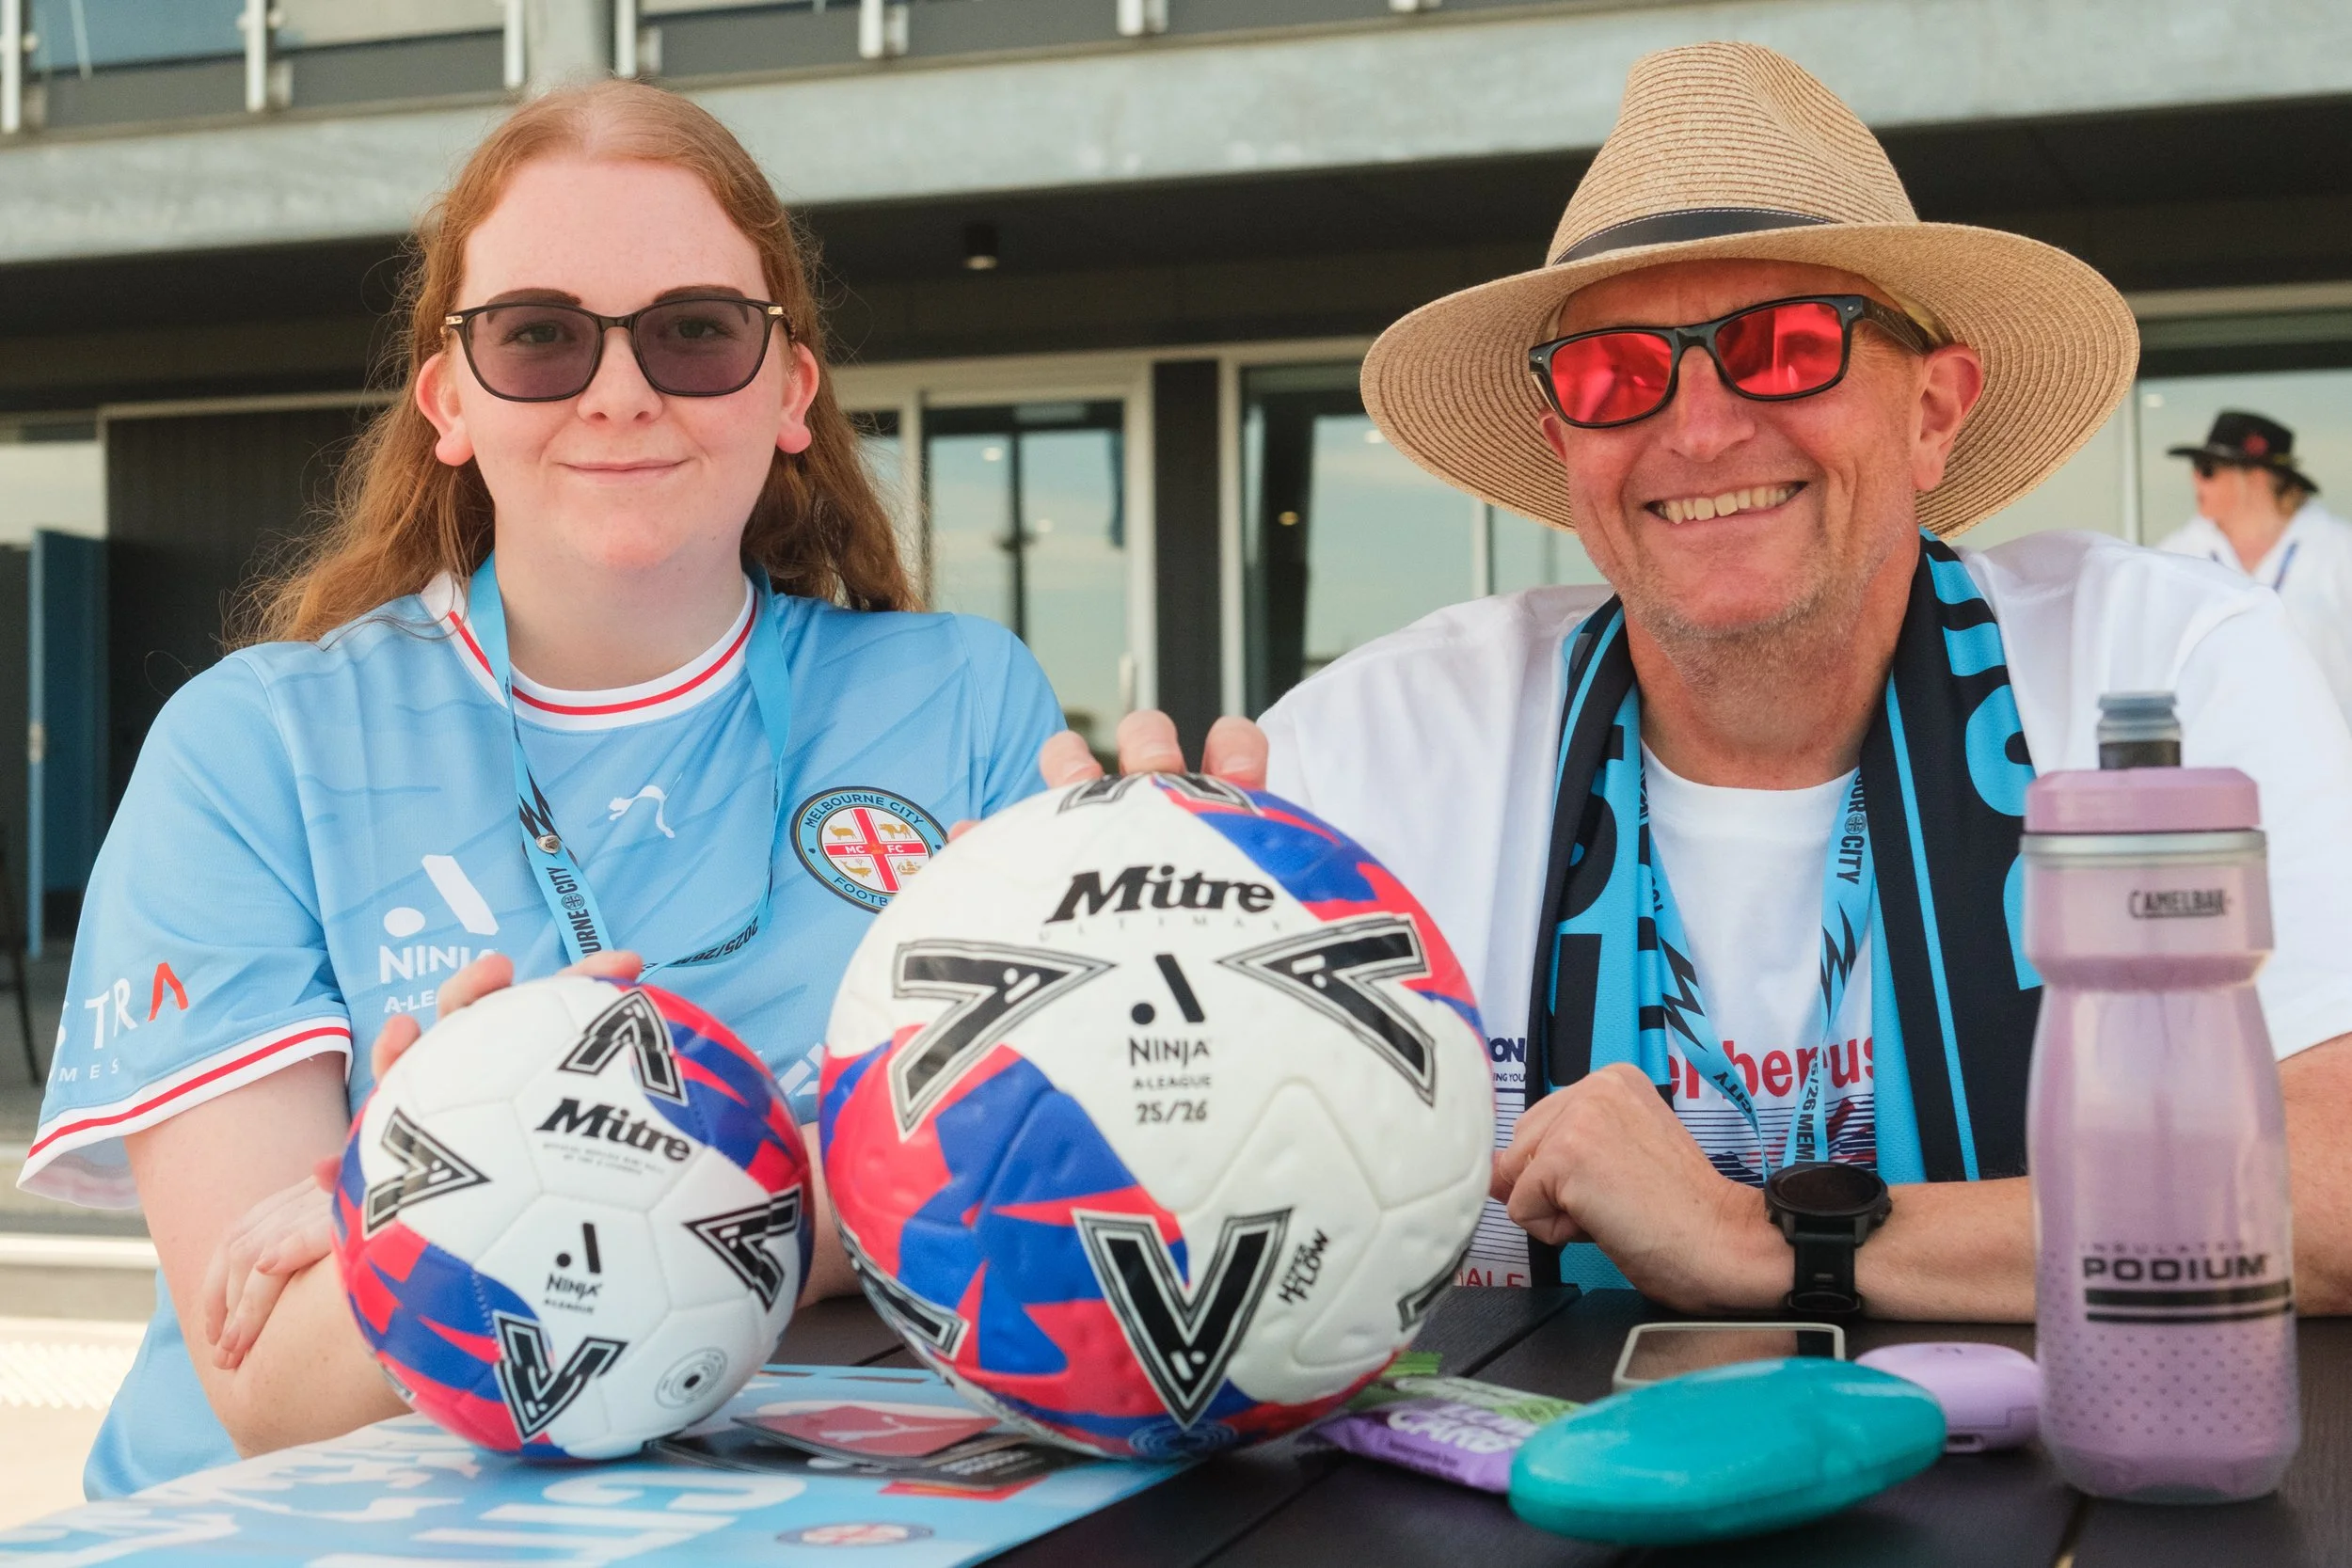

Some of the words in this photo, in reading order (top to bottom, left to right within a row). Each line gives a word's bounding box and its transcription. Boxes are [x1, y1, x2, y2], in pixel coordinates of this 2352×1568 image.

[804, 794, 884, 828] MELBOURNE
[889, 801, 924, 825] CITY
[845, 846, 866, 854] MC
[887, 845, 905, 853] FC
[1836, 835, 1865, 884] CITY
[547, 866, 579, 894] CITY
[1044, 864, 1275, 924] Mitre
[567, 909, 602, 957] URNE
[691, 915, 758, 962] 2025/26
[384, 990, 437, 1013] A-LE
[1130, 1037, 1210, 1068] NINJA
[1136, 1100, 1208, 1123] 25/26
[1712, 1071, 1753, 1115] CITY
[534, 1097, 691, 1162] Mitre
[1795, 1115, 1816, 1164] MEM
[2083, 1255, 2270, 1282] PODIUM
